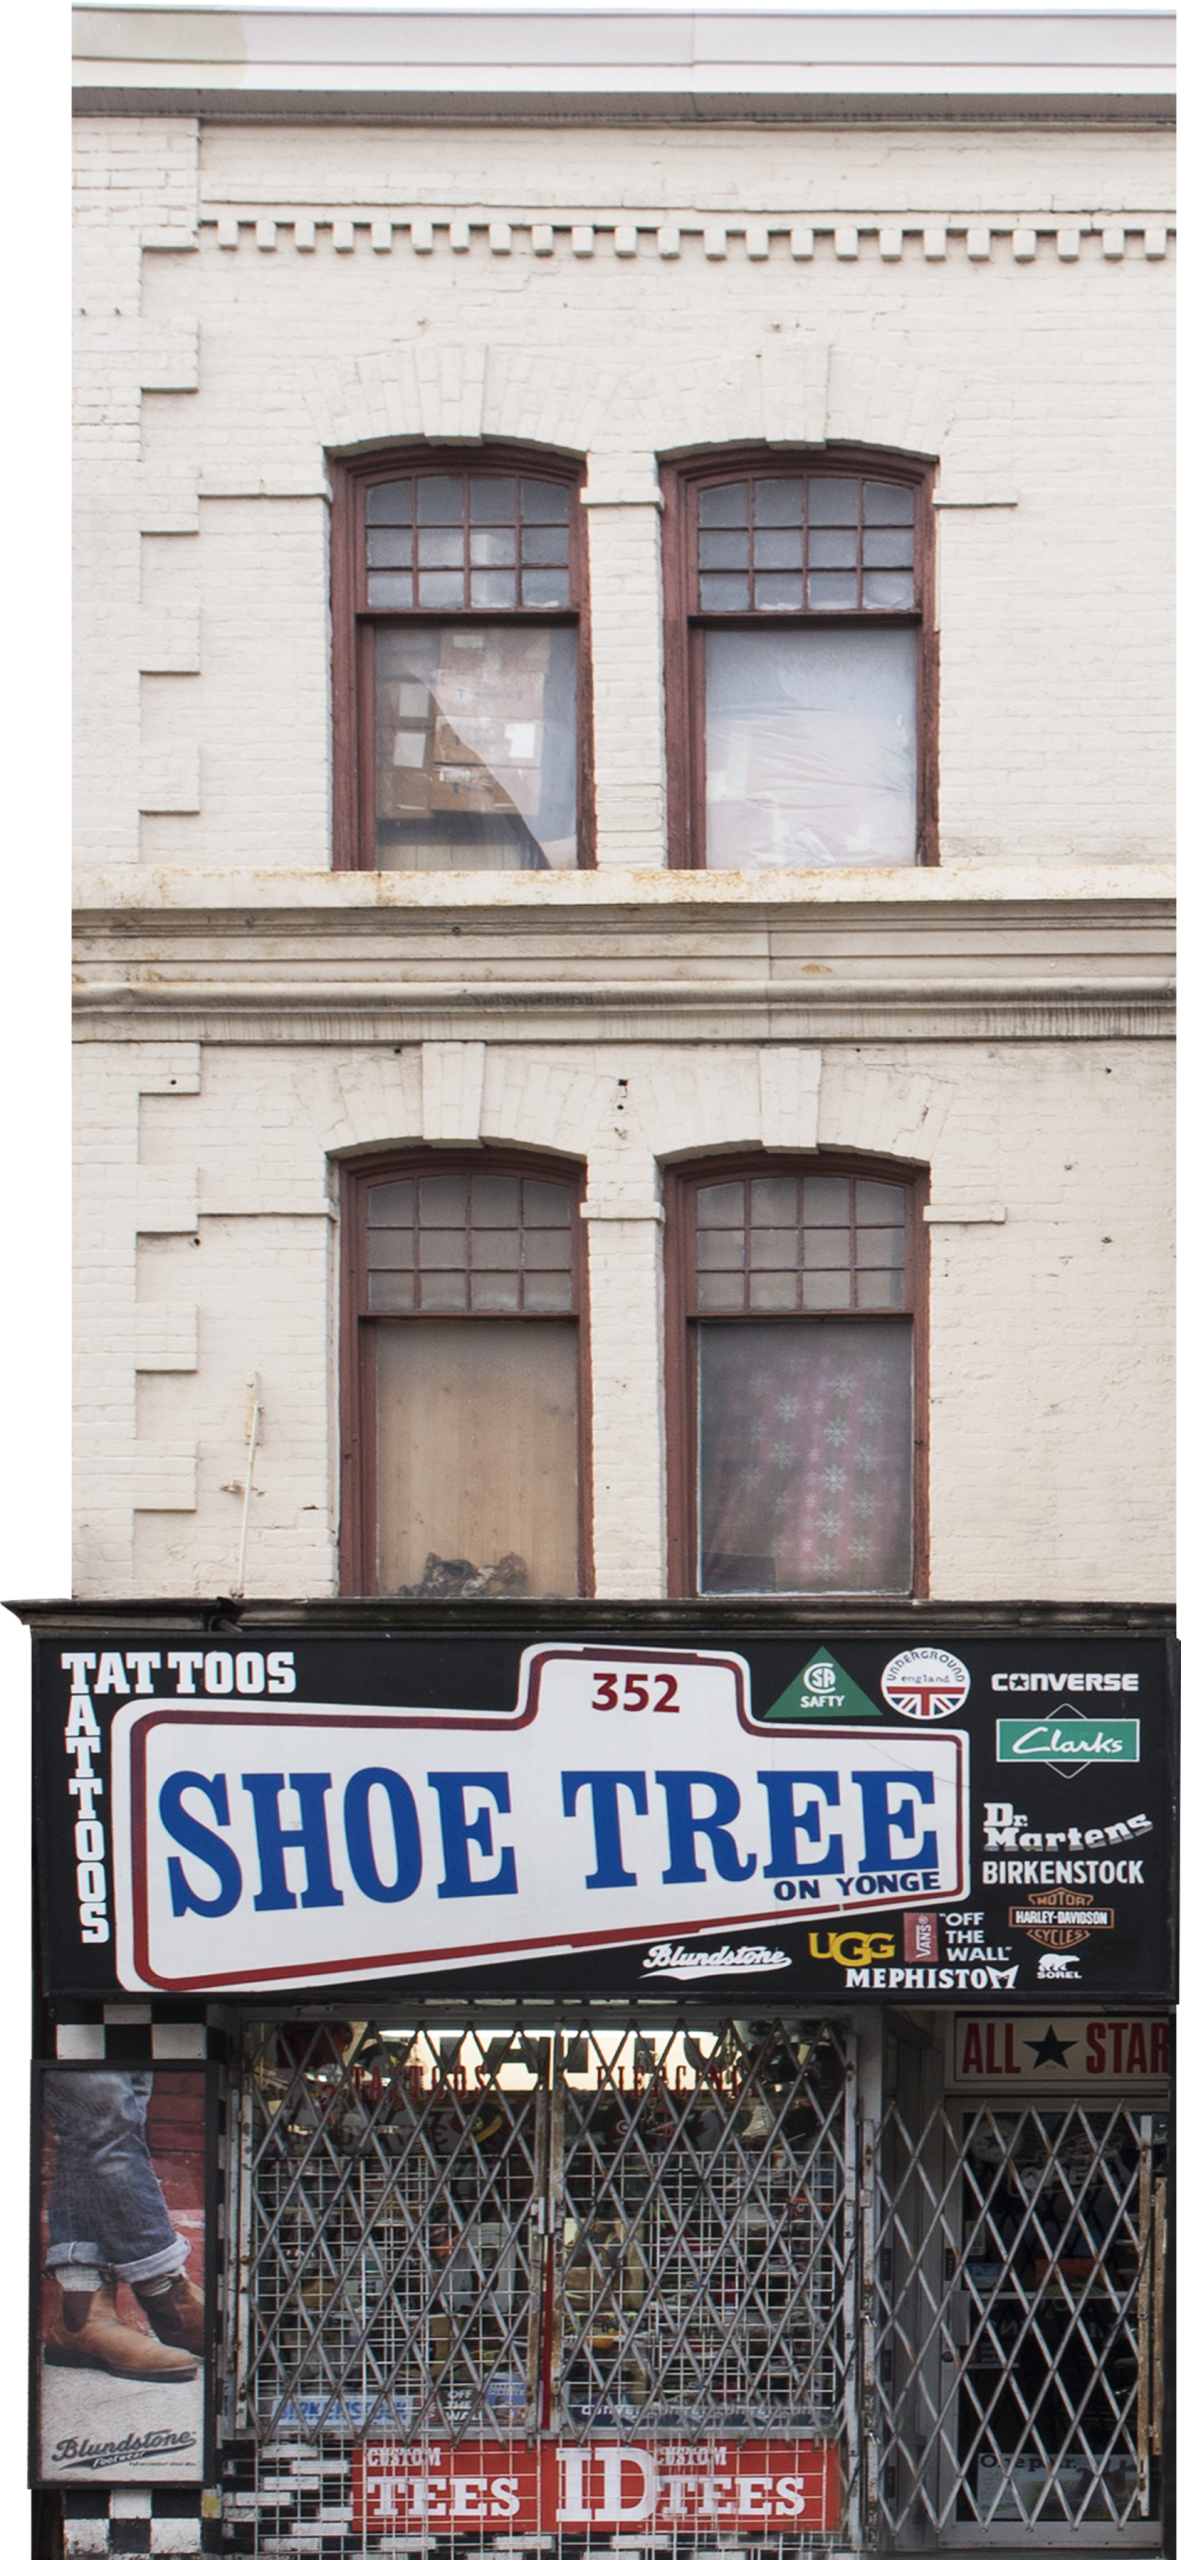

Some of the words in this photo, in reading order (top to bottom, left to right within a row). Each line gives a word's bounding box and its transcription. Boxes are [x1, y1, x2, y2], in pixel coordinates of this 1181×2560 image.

[61, 1652, 296, 1694] TATTOOS
[886, 1650, 965, 1683] UNDERGROUND
[901, 1674, 950, 1684] england
[591, 1673, 680, 1713] 352
[991, 1673, 1139, 1692] CONVERSE
[800, 1695, 845, 1708] SAFTY
[1012, 1726, 1123, 1755] Clarks
[983, 1802, 1028, 1827] Dr.
[159, 1767, 518, 1918] SHOE
[561, 1771, 939, 1889] TREE
[983, 1813, 1153, 1851] Martens
[982, 1860, 1145, 1884] BIRKENSTOCK
[774, 1879, 820, 1901] ON
[836, 1871, 941, 1897] YONGE
[1036, 1889, 1086, 1906] MOTOR
[1015, 1911, 1108, 1925] HARLEY-DAVIDSON
[808, 1932, 895, 1967] UGG
[945, 1930, 985, 1944] THE
[1034, 1928, 1083, 1946] CYCLES
[642, 1943, 792, 1969] Blundstone
[1037, 1971, 1082, 1979] SOREL
[962, 2022, 1021, 2074] ALL
[1086, 2022, 1169, 2074] STAR
[52, 2429, 197, 2462] Blundstone
[367, 2446, 442, 2467] CUSTOM
[655, 2446, 728, 2466] CUSTOM
[367, 2476, 521, 2517] TEES
[555, 2446, 657, 2522] ID
[656, 2475, 806, 2517] TEES
